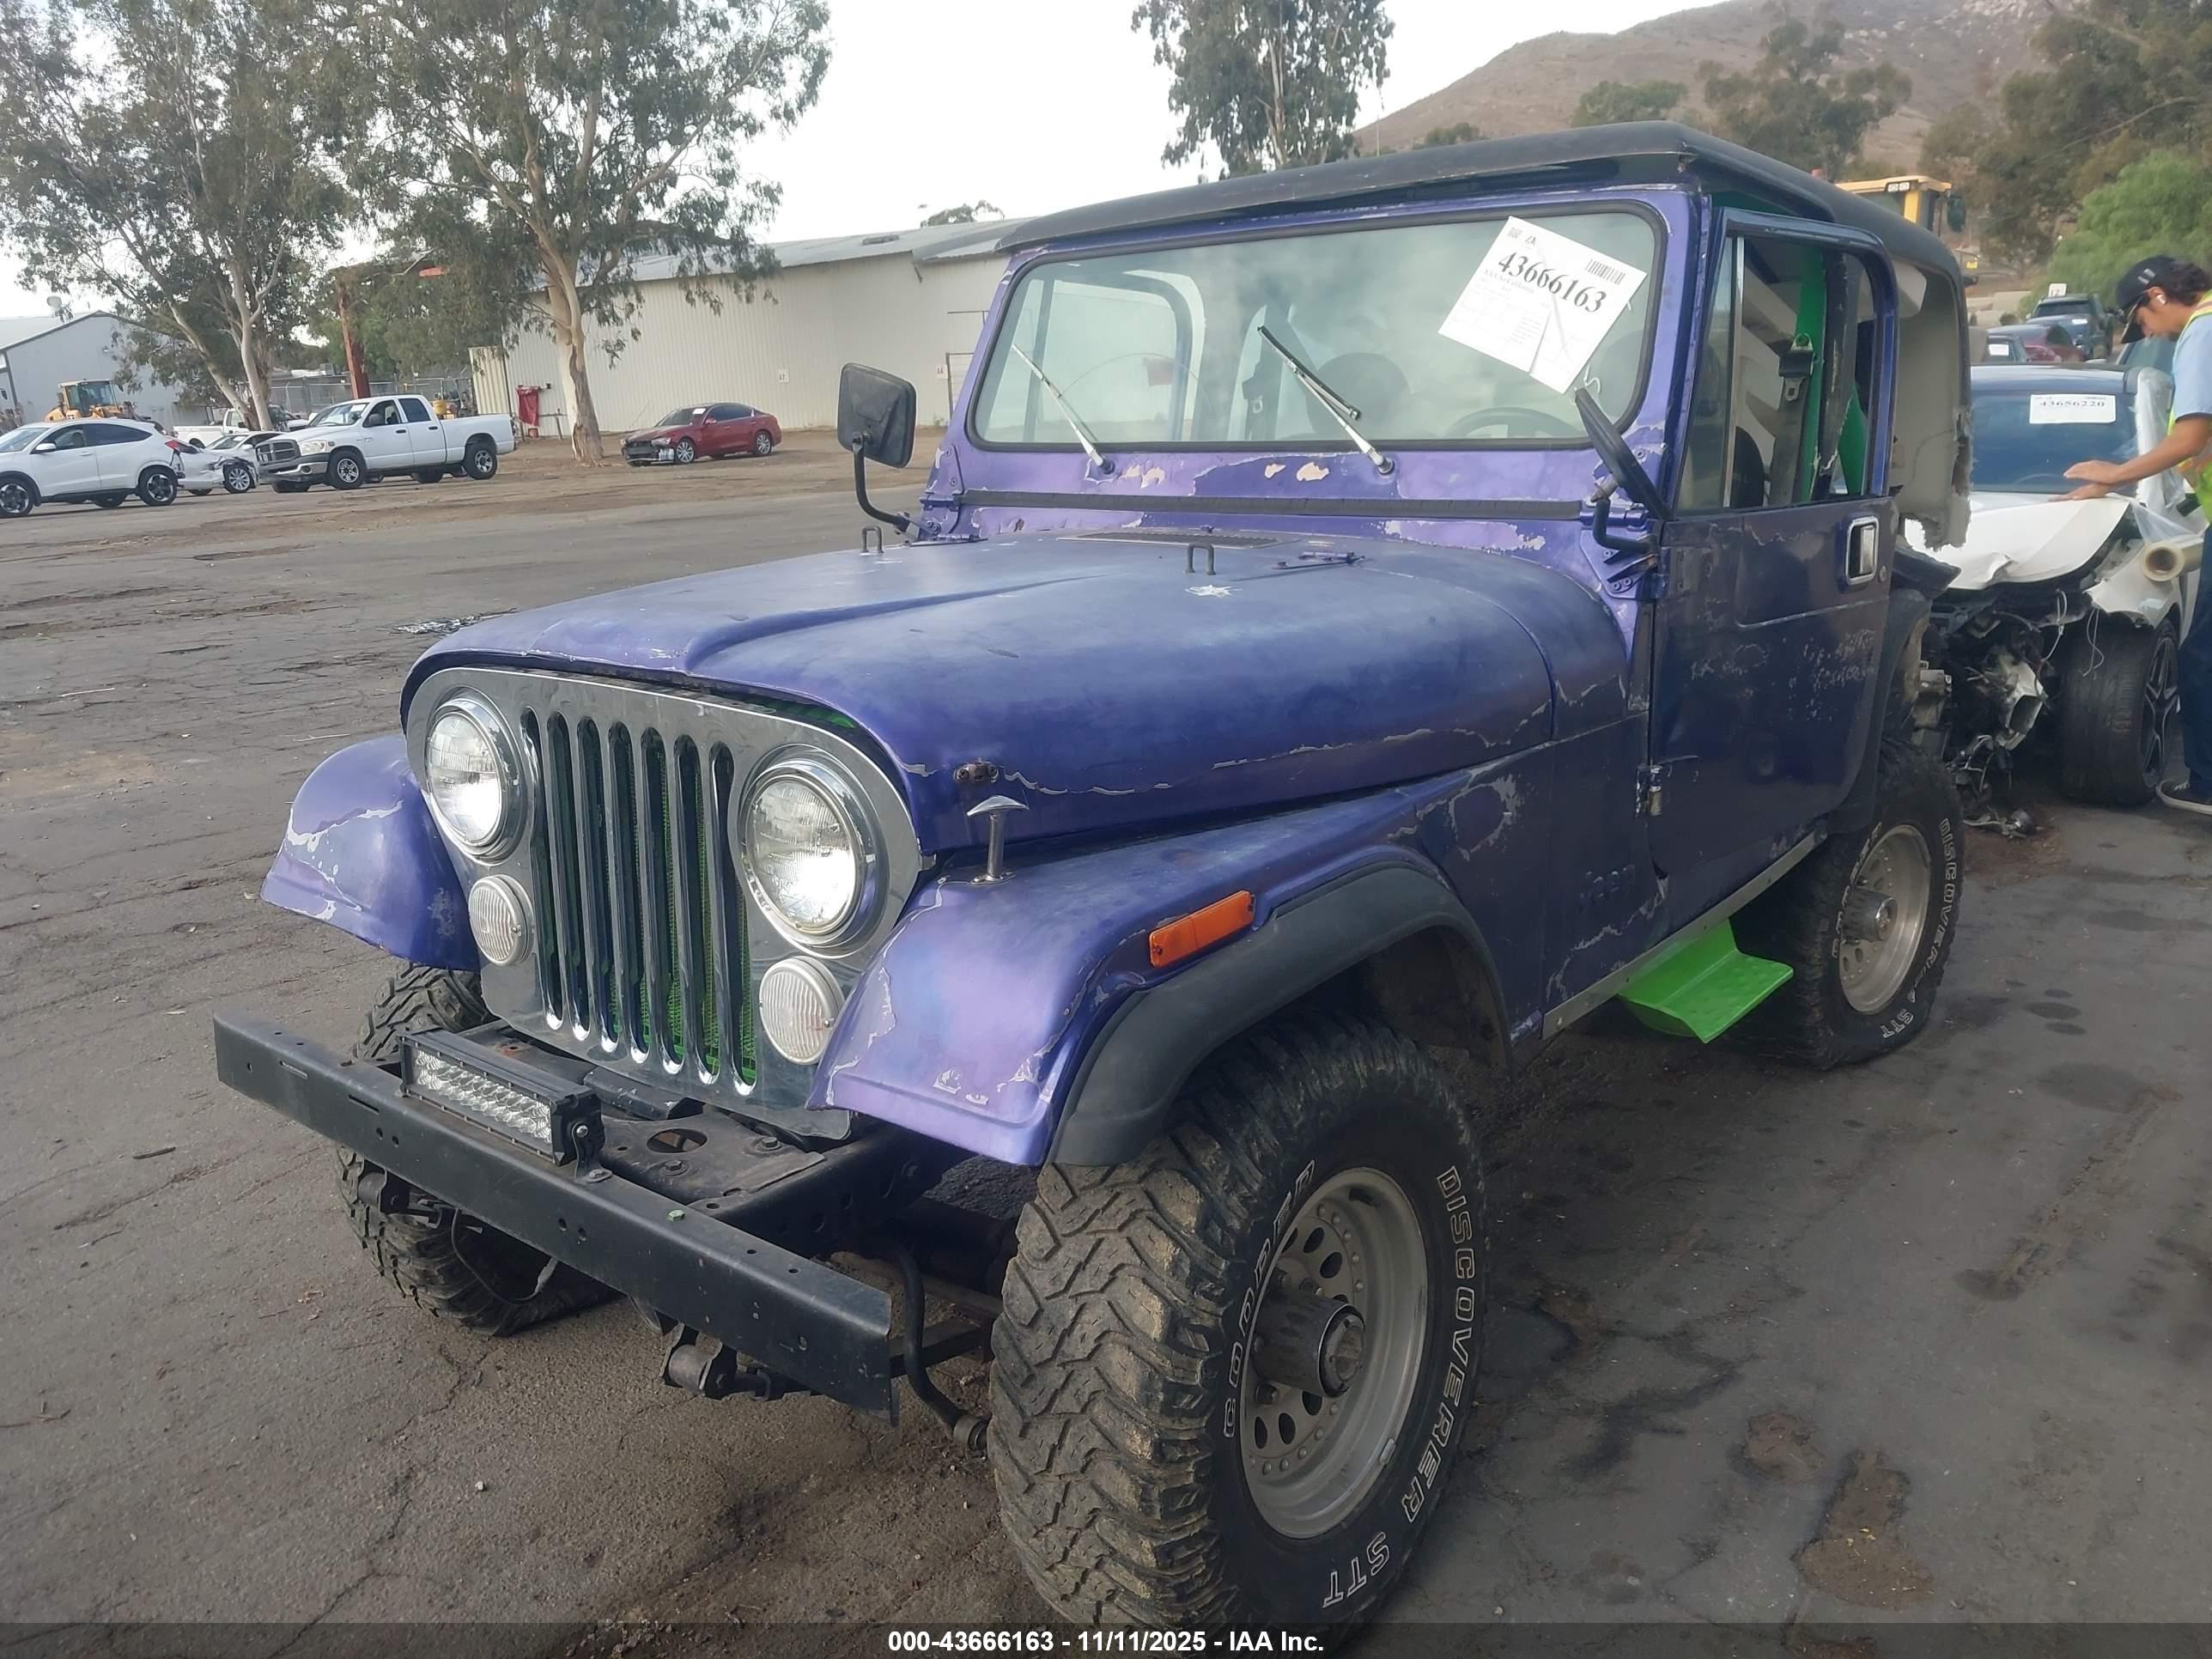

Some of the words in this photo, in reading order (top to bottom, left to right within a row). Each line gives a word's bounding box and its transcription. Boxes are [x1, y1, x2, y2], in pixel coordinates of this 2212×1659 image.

[1497, 252, 1607, 313] 43666163
[1880, 1007, 1914, 1040] STT
[1402, 1164, 1475, 1523] DISCOVERER
[1322, 1531, 1391, 1608] STT
